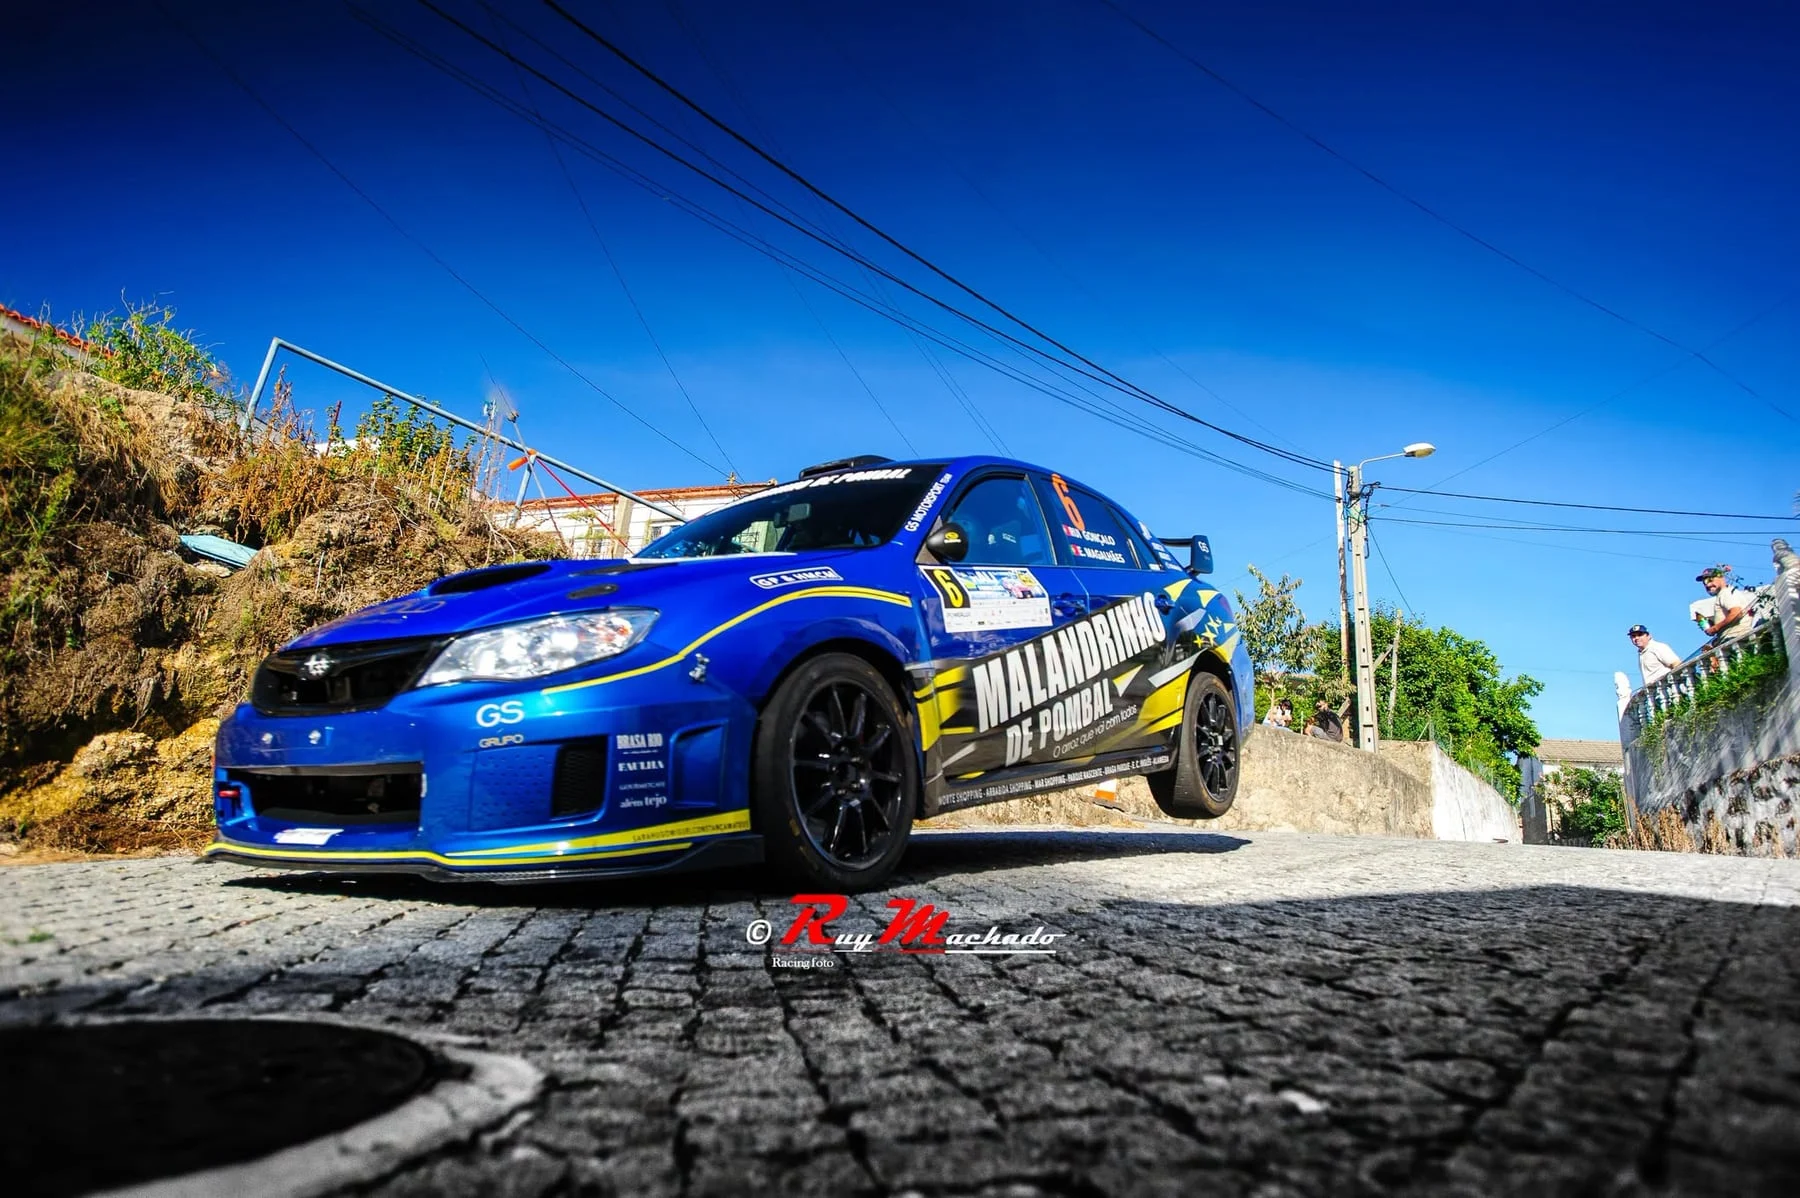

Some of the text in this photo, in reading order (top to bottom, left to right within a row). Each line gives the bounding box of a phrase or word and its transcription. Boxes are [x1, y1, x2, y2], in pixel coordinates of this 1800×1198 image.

[910, 481, 946, 523] MOTORSPORT
[1052, 473, 1085, 532] 6
[904, 520, 920, 532] GS
[757, 577, 779, 586] GP
[932, 569, 964, 608] 6
[972, 591, 1166, 733] MALANDRINHO
[476, 700, 525, 728] GS
[1005, 678, 1114, 767] DE POMBAL
[1053, 745, 1061, 759] O
[1080, 729, 1095, 745] que
[1105, 713, 1121, 730] com
[1120, 703, 1138, 722] todos
[479, 734, 524, 748] GRUPO
[956, 788, 983, 803] SHOPPING
[1009, 780, 1033, 794] SHOPPING
[1044, 773, 1066, 786] SHOPPING
